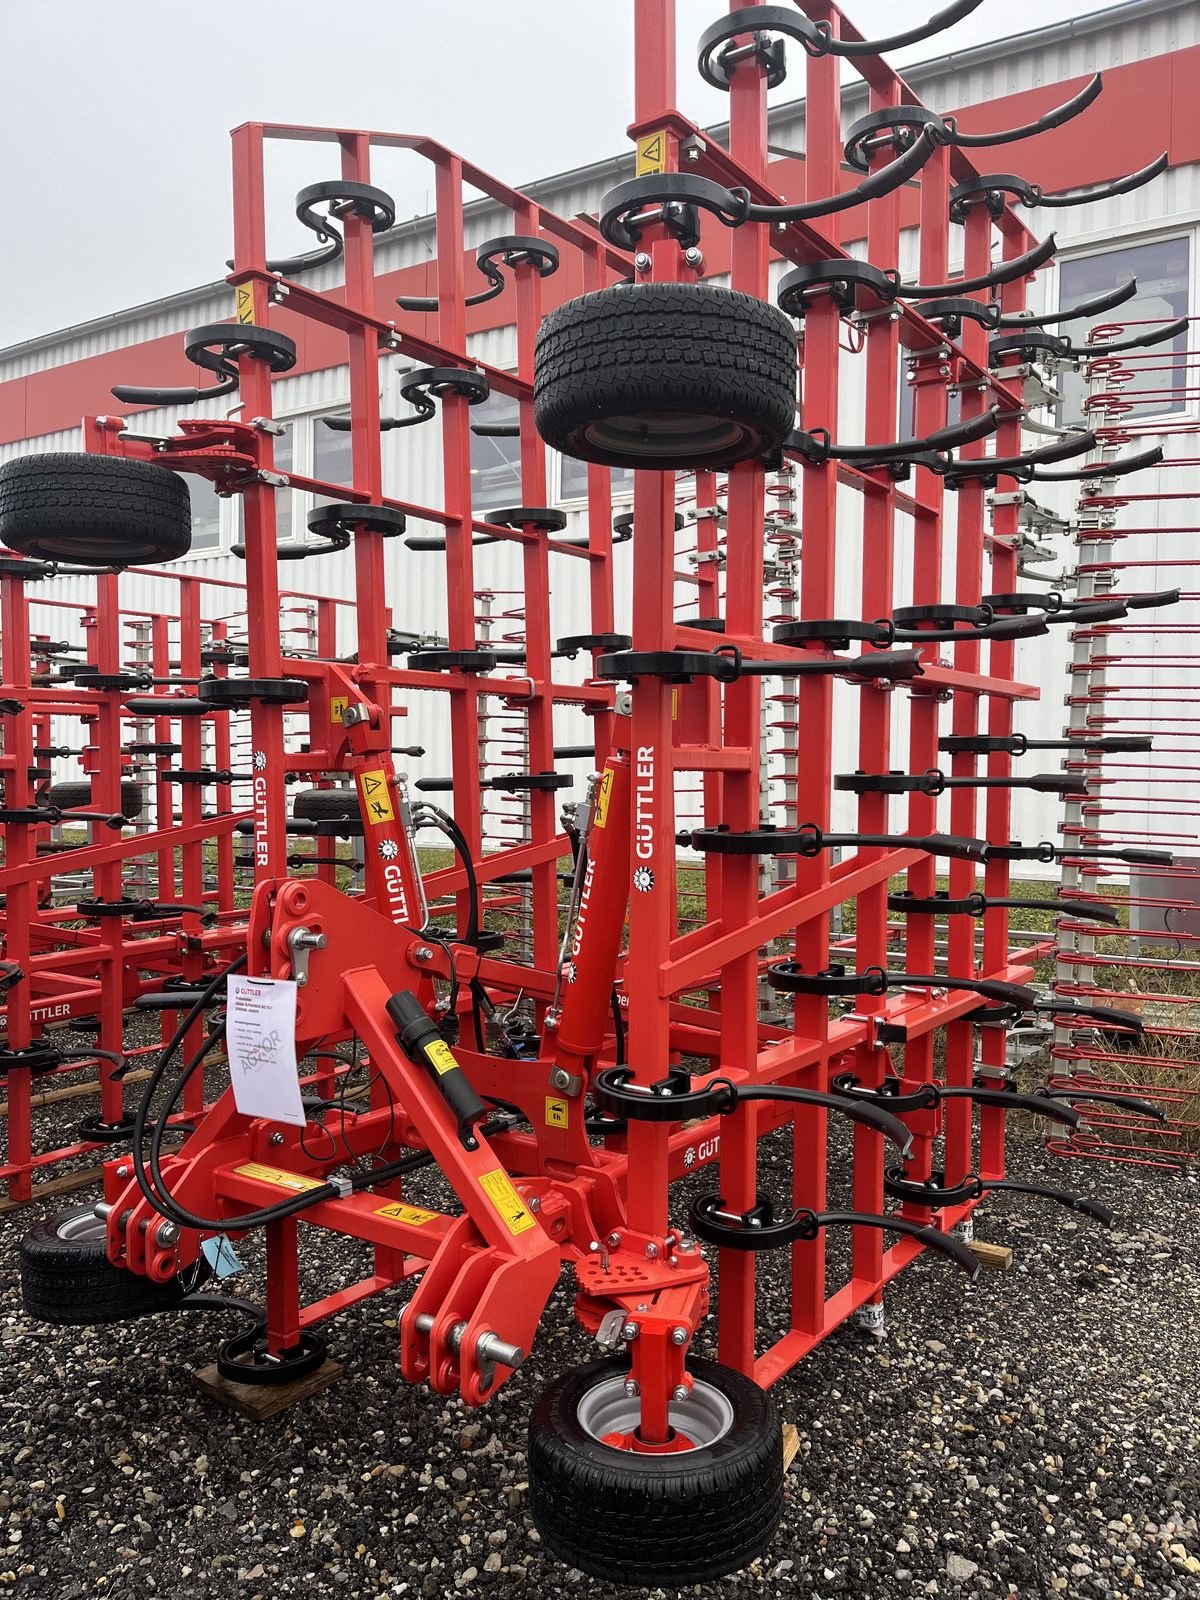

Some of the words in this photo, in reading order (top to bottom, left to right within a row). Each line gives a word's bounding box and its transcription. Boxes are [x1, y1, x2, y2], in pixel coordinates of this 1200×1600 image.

[254, 776, 269, 867] GÜTTLER
[636, 745, 654, 860] GÜTTLER
[384, 865, 410, 925] GÜTTL
[30, 1003, 71, 1021] TTLER
[552, 1112, 561, 1121] 8h
